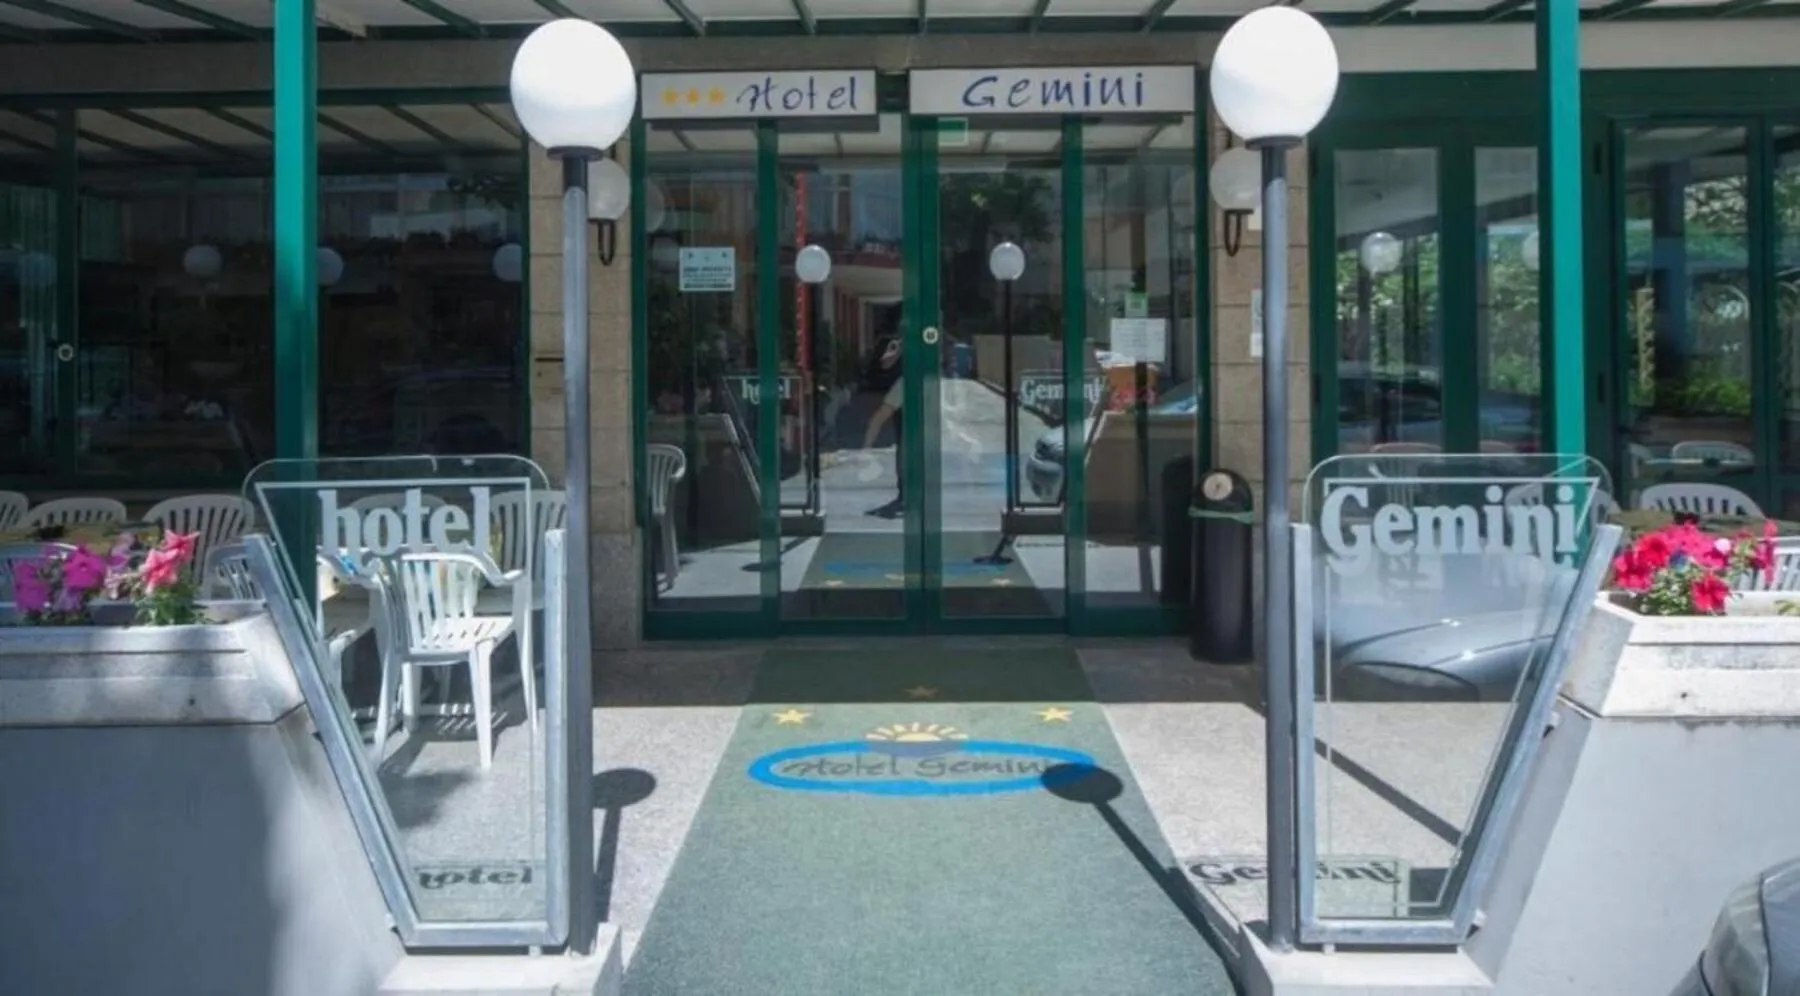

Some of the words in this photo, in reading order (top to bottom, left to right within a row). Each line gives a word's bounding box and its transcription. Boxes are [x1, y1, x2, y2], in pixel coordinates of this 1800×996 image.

[736, 76, 858, 113] Hotel
[961, 72, 1144, 108] Gemini
[318, 487, 493, 577] hotel
[1320, 484, 1577, 577] Gemini
[781, 754, 901, 776] Hotel
